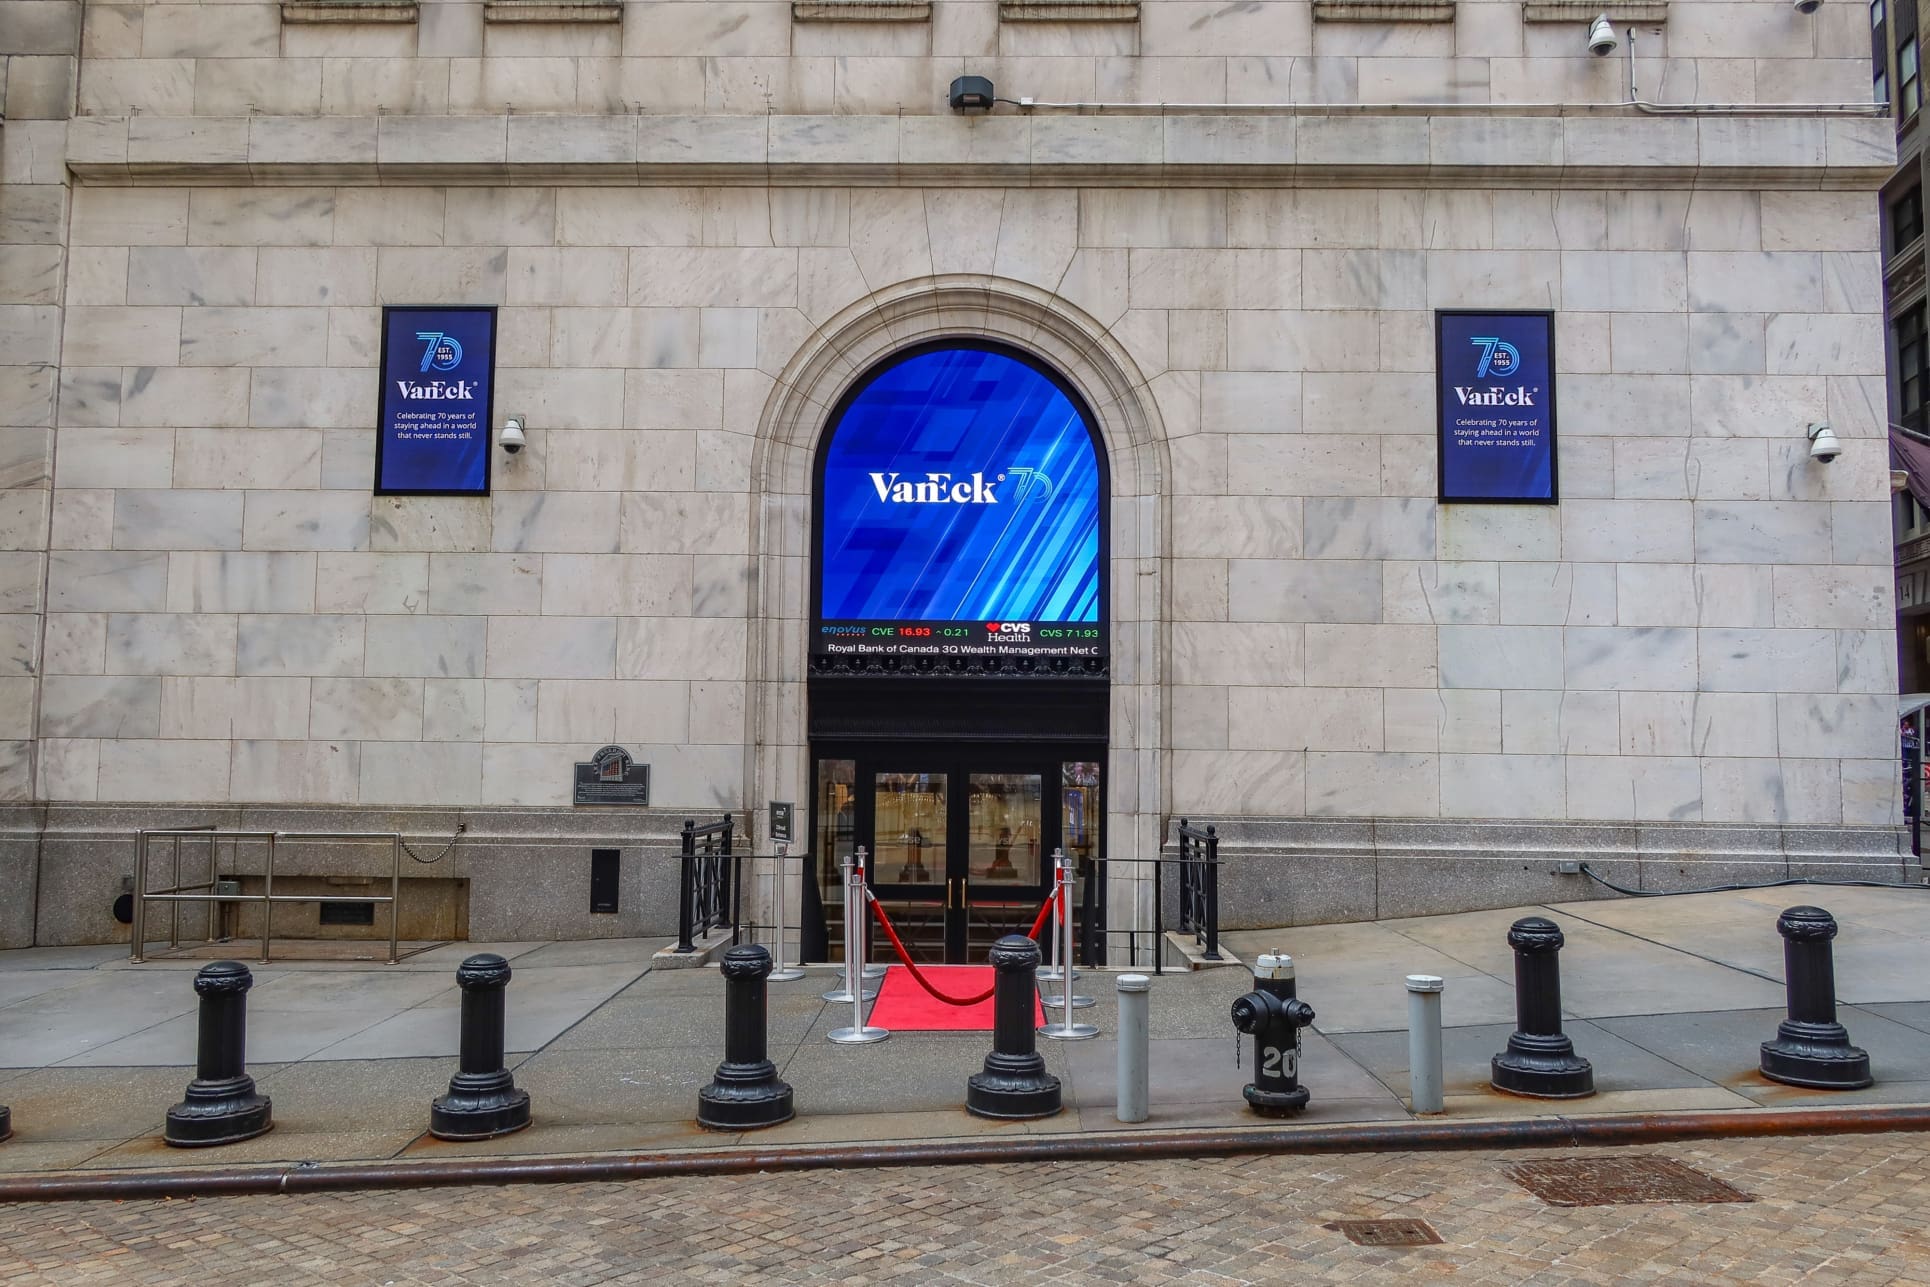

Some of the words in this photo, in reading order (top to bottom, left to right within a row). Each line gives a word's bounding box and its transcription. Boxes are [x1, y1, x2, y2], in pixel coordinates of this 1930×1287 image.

[396, 412, 436, 421] Celebrating
[394, 422, 419, 431] staying
[1456, 418, 1497, 427] Celebrating
[1498, 418, 1507, 426] 70
[1508, 419, 1529, 428] years
[1529, 418, 1538, 426] of
[1453, 429, 1480, 438] staying
[1521, 439, 1536, 447] still.
[871, 627, 895, 636] CVE
[898, 627, 931, 637] 16.93
[943, 628, 969, 637] 0.21
[1000, 622, 1031, 633] CVS
[987, 632, 1031, 643] Health
[1040, 629, 1063, 638] CVS
[827, 643, 856, 653] Royal
[858, 644, 884, 653] Bank
[886, 644, 897, 653] of
[899, 644, 939, 653] Canada
[941, 645, 958, 654] 3Q
[960, 645, 996, 654] Wealth
[999, 645, 1068, 656] Management
[1070, 646, 1089, 655] Net
[1262, 1046, 1297, 1079] 20
